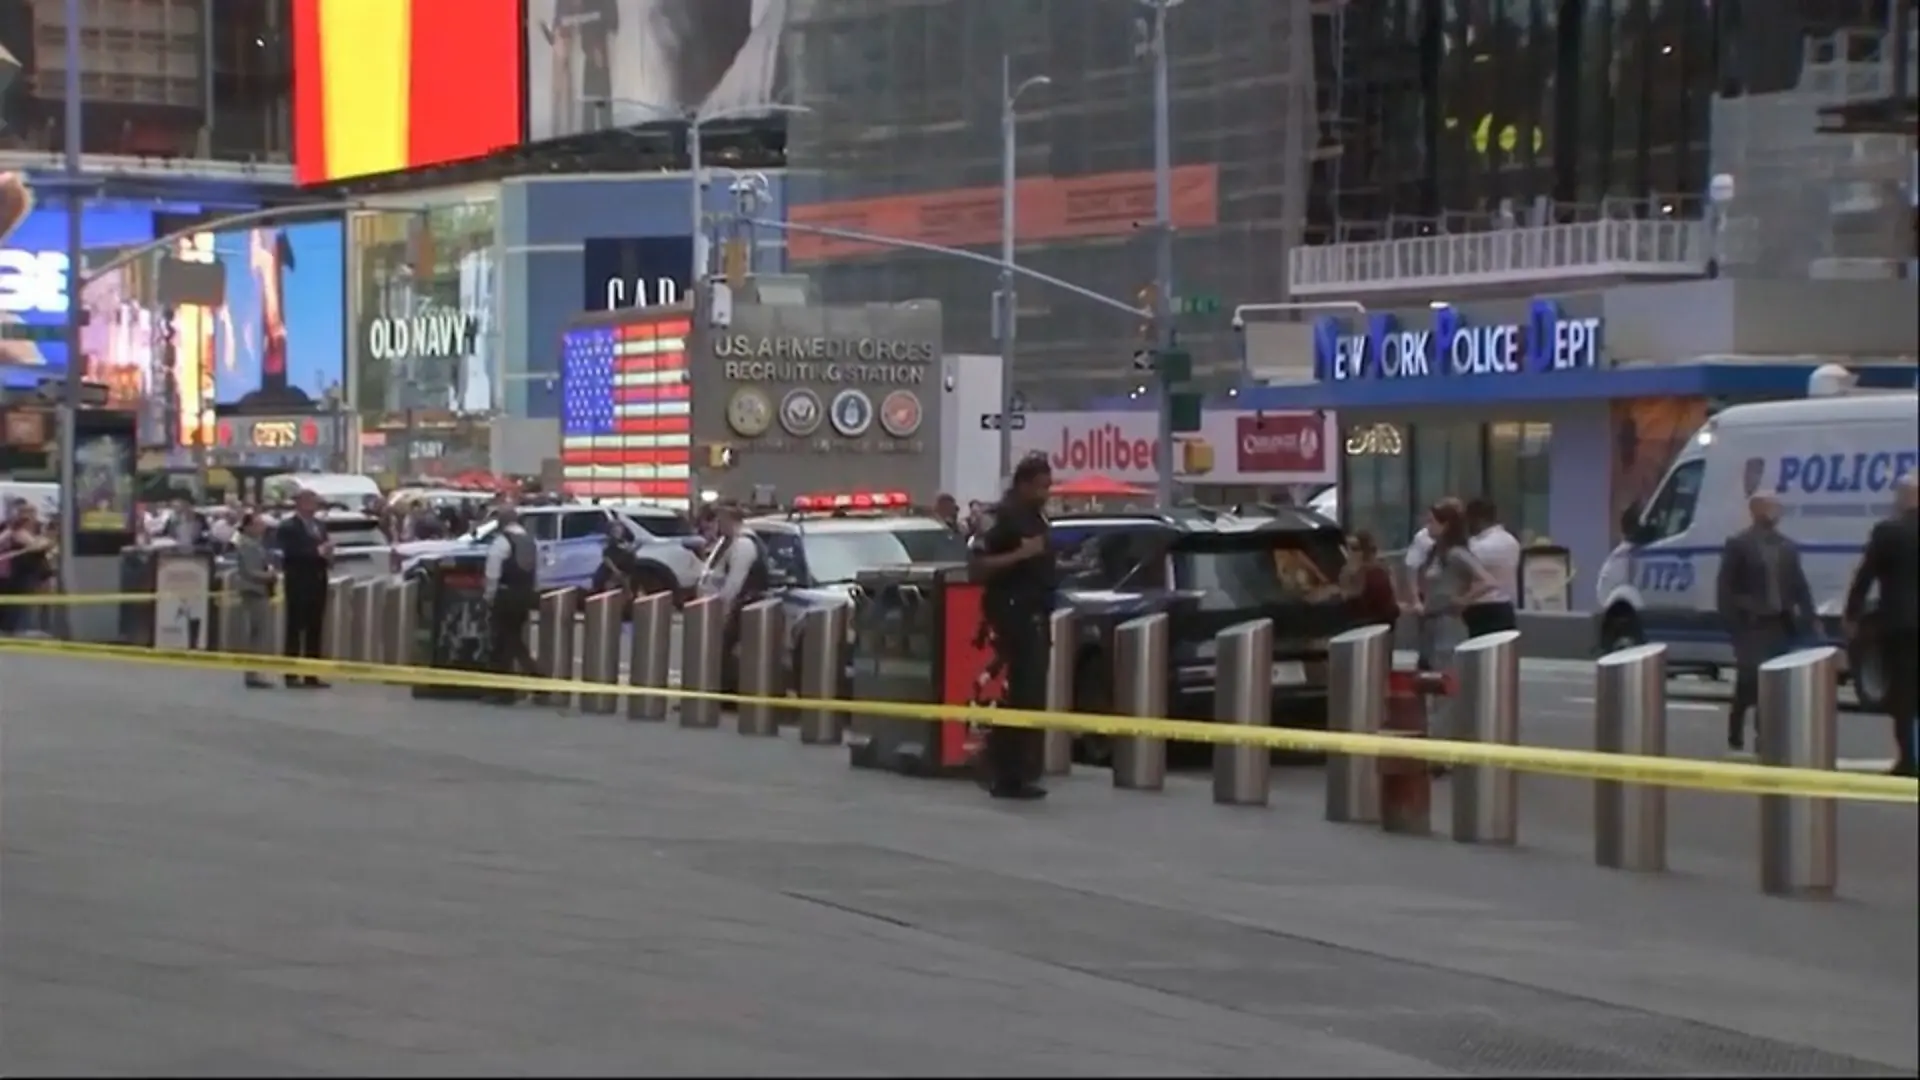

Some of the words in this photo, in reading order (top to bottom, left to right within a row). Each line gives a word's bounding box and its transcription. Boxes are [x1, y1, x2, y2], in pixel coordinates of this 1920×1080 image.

[370, 319, 408, 359] OLD
[412, 313, 467, 356] NAVY
[757, 336, 840, 359] ARMED
[845, 338, 933, 363] FORCES
[1314, 315, 1365, 380] NEW
[1368, 313, 1429, 378] YORK
[1435, 306, 1519, 374] POLICE
[1529, 297, 1599, 373] DEPT
[726, 361, 841, 382] RECRUITING
[845, 364, 925, 385] STATION
[1776, 453, 1918, 494] POLICE
